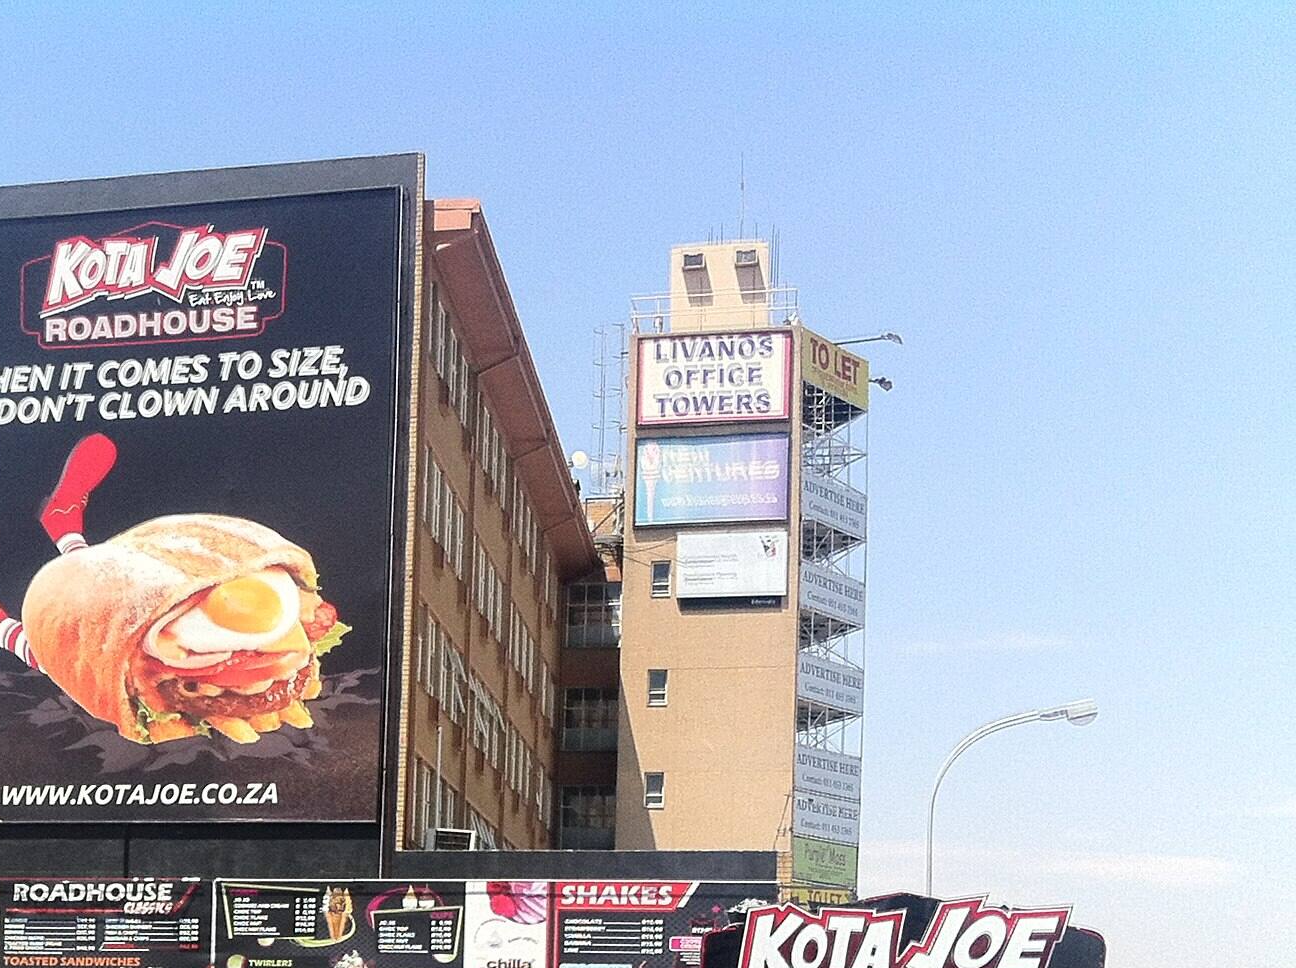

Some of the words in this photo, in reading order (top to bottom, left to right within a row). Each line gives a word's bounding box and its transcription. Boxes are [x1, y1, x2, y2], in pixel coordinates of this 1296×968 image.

[47, 240, 148, 305] KOTA
[154, 230, 257, 290] JOE
[251, 279, 266, 290] TM
[188, 293, 212, 307] Eat
[214, 290, 245, 307] Enjoy
[247, 290, 277, 302] Love
[45, 306, 259, 342] ROADHOUSE
[654, 335, 773, 363] LIVANOS
[810, 337, 830, 370] TO
[834, 349, 860, 385] LET
[59, 362, 93, 390] IT
[97, 356, 210, 390] COMES
[218, 350, 263, 381] TO
[268, 345, 350, 381] SIZE,
[664, 362, 763, 389] OFFICE
[98, 386, 222, 421] CLOWN
[223, 375, 372, 414] AROUND
[654, 388, 771, 417] TOWERS
[804, 480, 845, 508] ADVERTISE
[846, 497, 865, 515] HERE
[802, 570, 844, 596] ADVERTISE
[845, 584, 864, 602] HERE
[800, 661, 842, 686] ADVERTISE
[843, 673, 862, 690] HERE
[797, 753, 839, 773] ADVERTISE
[840, 762, 859, 776] HERE
[1, 783, 278, 805] WWW.KOTAJOE.CO.ZA
[797, 798, 837, 817] ADVERTISE
[839, 806, 858, 821] HERE
[13, 883, 173, 902] ROADHOUSE
[560, 885, 673, 906] SHAKES
[3, 956, 59, 966] TOASTED
[60, 957, 141, 967] SANDWICHES
[487, 958, 532, 968] chilla
